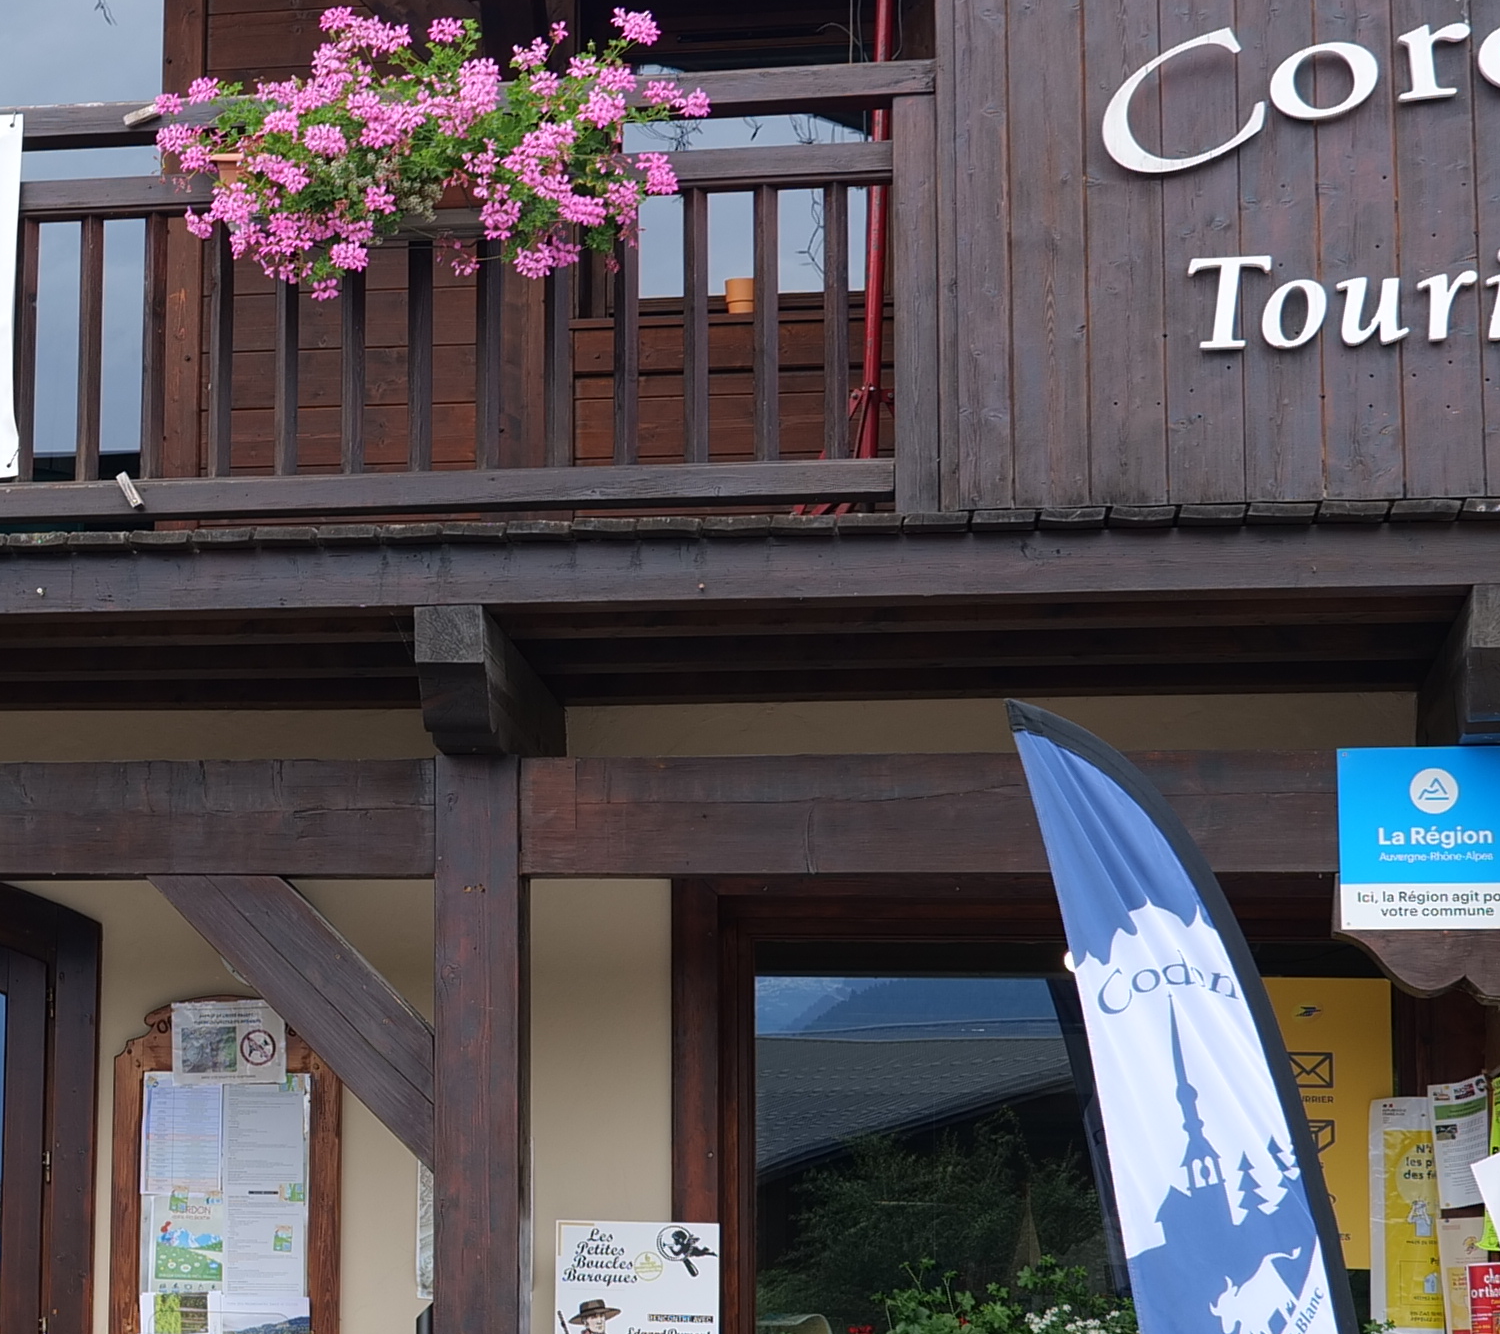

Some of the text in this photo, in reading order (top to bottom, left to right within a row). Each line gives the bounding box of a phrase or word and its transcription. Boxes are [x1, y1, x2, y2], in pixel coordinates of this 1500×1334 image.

[1377, 825, 1494, 849] La Région
[1378, 851, 1494, 864] Auvergne-Rhône-Alpes
[1357, 890, 1379, 905] Ici,
[1382, 890, 1395, 903] la
[1398, 890, 1449, 905] Région
[1452, 890, 1480, 905] agit
[1380, 906, 1495, 917] votre commune
[587, 1228, 613, 1242] Les
[575, 1241, 625, 1256] Petites
[572, 1255, 633, 1270] Boucles
[562, 1268, 637, 1287] Baroques
